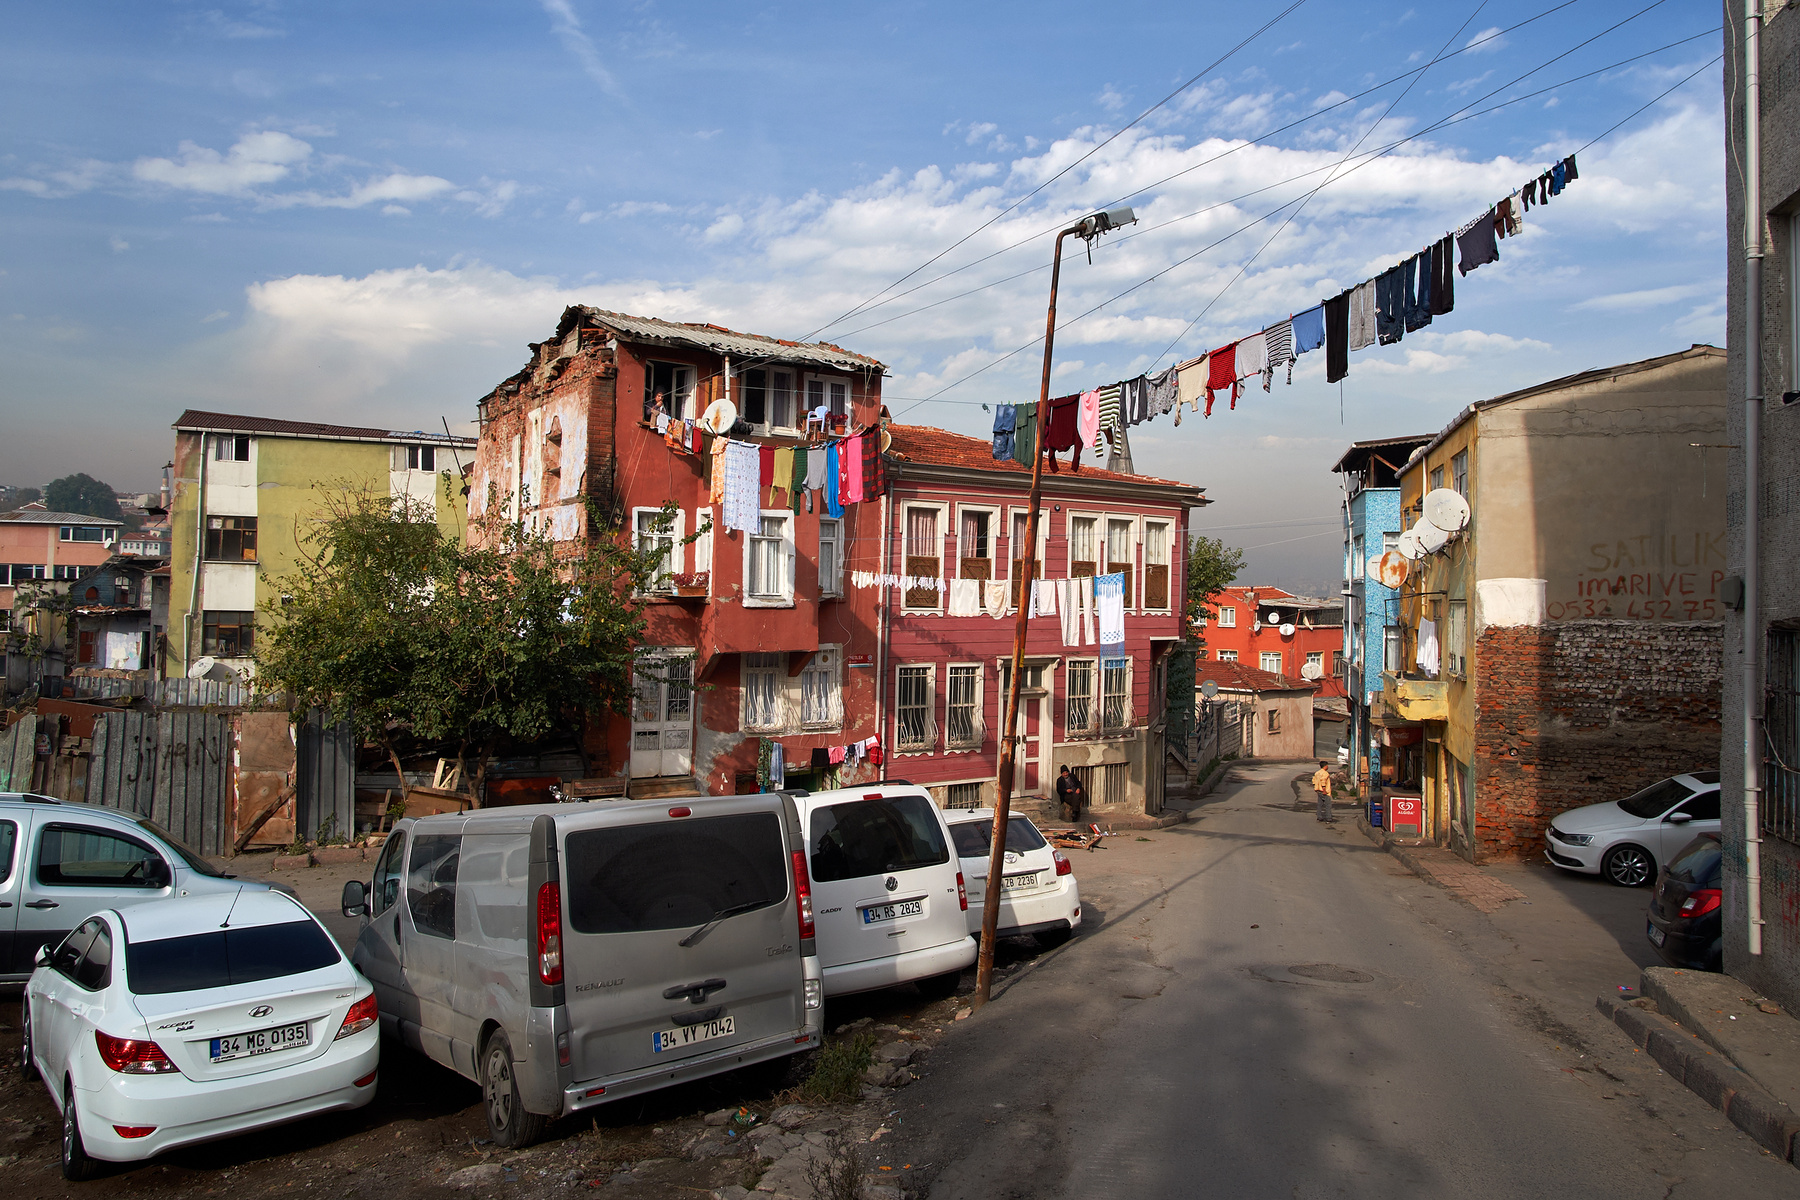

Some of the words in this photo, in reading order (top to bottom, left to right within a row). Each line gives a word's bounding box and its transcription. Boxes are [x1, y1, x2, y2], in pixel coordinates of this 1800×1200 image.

[1587, 531, 1727, 573] SATILIK
[1547, 599, 1614, 620] 0532
[1626, 599, 1675, 620] 452
[1682, 598, 1716, 621] 75
[1004, 878, 1015, 888] ZB
[1017, 876, 1036, 886] 2236
[820, 907, 843, 915] CADDY
[869, 909, 881, 921] 34
[884, 906, 896, 918] RS
[900, 902, 921, 915] 2829
[575, 978, 626, 993] RENAULT
[156, 1019, 196, 1031] ACCENT
[661, 1032, 676, 1048] 34
[683, 1026, 697, 1042] VY
[703, 1018, 733, 1038] 7042
[221, 1037, 240, 1054] 34
[246, 1033, 265, 1049] MG
[271, 1026, 304, 1044] 0135
